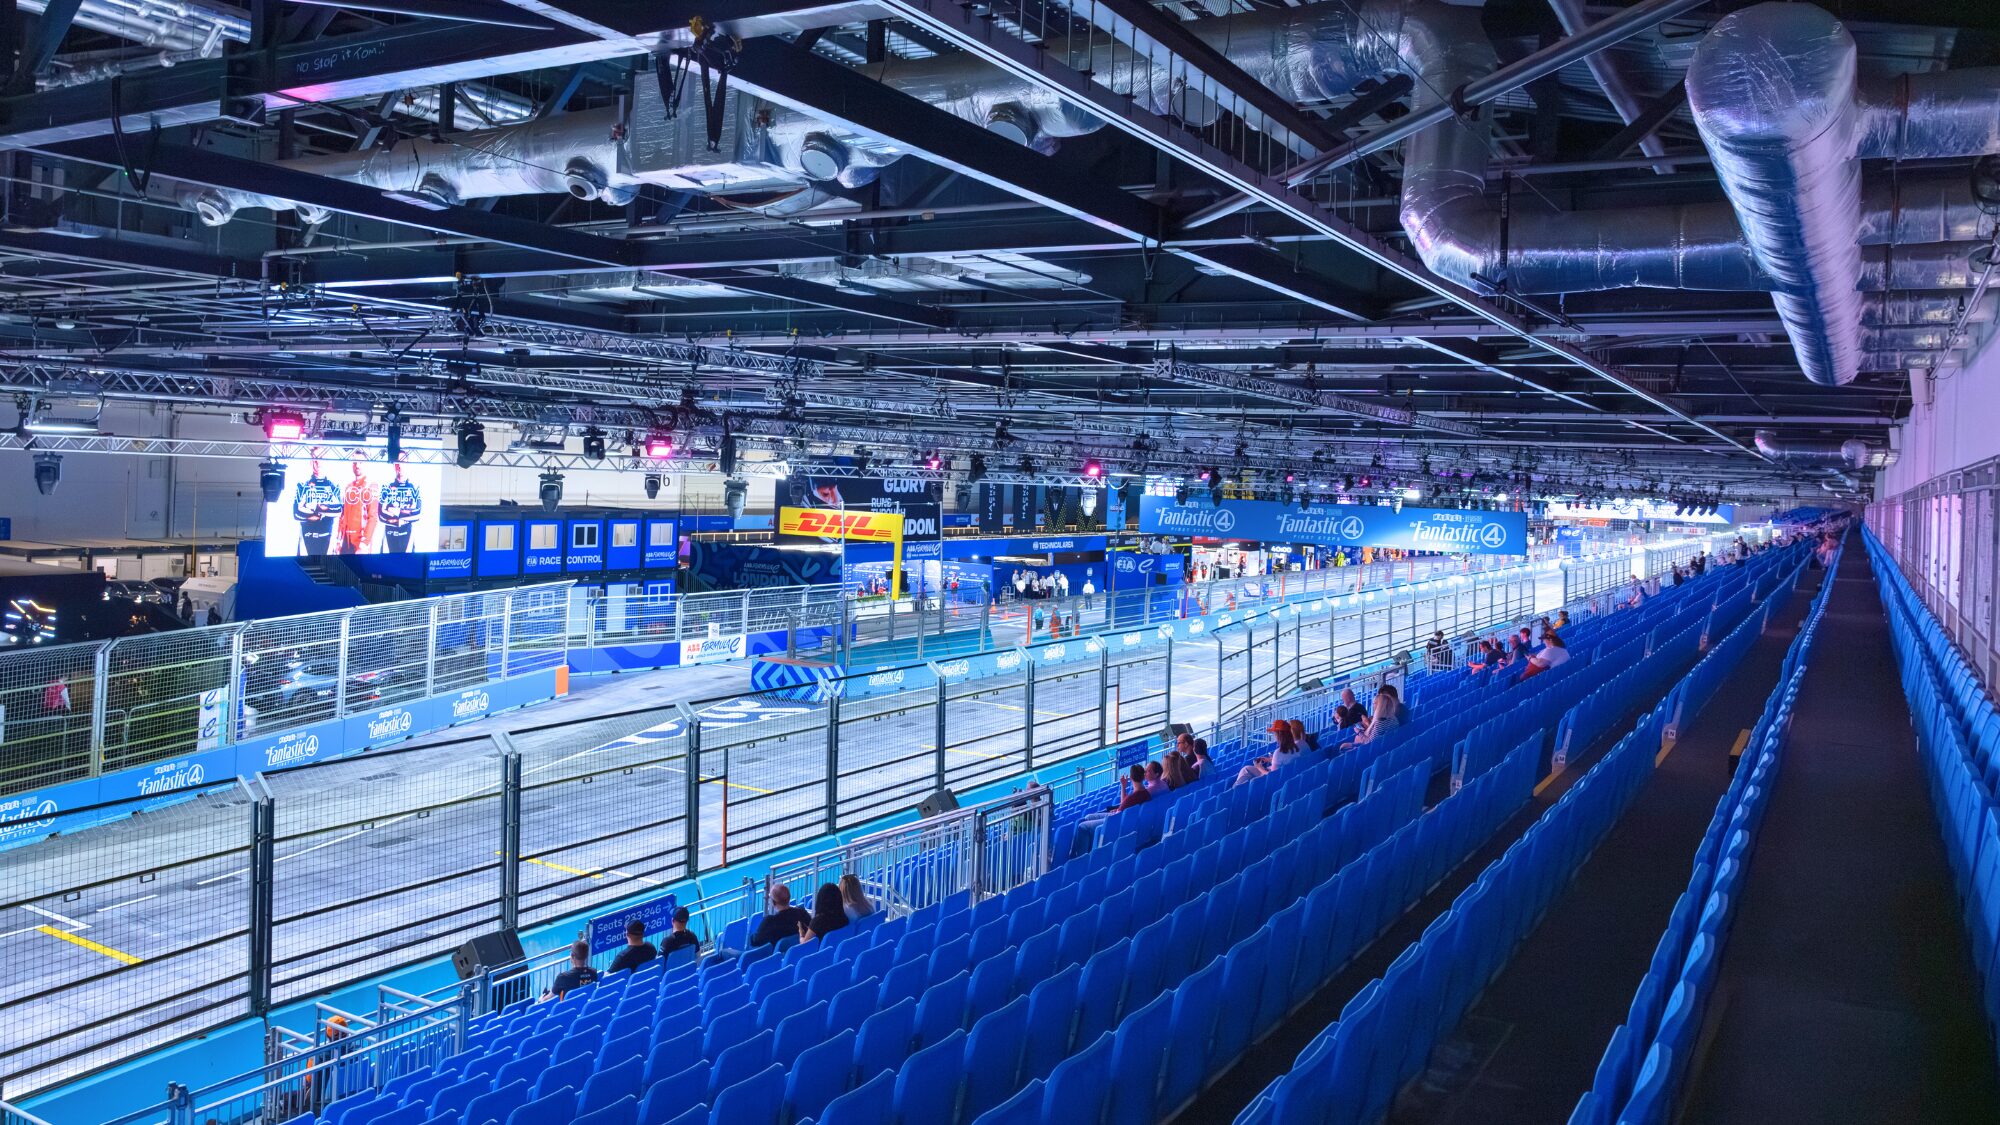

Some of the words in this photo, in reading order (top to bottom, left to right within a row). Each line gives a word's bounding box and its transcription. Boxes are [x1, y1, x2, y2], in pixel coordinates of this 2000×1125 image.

[341, 48, 352, 60] it
[884, 478, 926, 492] GLORY
[872, 498, 892, 508] RUNS
[798, 512, 876, 536] DHL
[1158, 507, 1214, 526] Fantastic
[1280, 514, 1340, 534] Fantastic
[1412, 520, 1481, 542] Fantastic
[1482, 524, 1504, 546] 4
[540, 556, 562, 566] RACE
[566, 555, 602, 564] CONTROL
[1116, 558, 1134, 570] FIA
[734, 572, 790, 586] LONDON
[687, 644, 700, 652] ABB
[701, 639, 731, 652] FORMULA
[454, 696, 480, 717] Fantastic
[370, 715, 401, 738] Fantastic
[268, 740, 306, 766] Fantastic
[141, 770, 188, 795] Fantastic
[598, 920, 623, 934] Seats
[606, 930, 627, 945] Seat
[644, 916, 666, 931] 7-261
